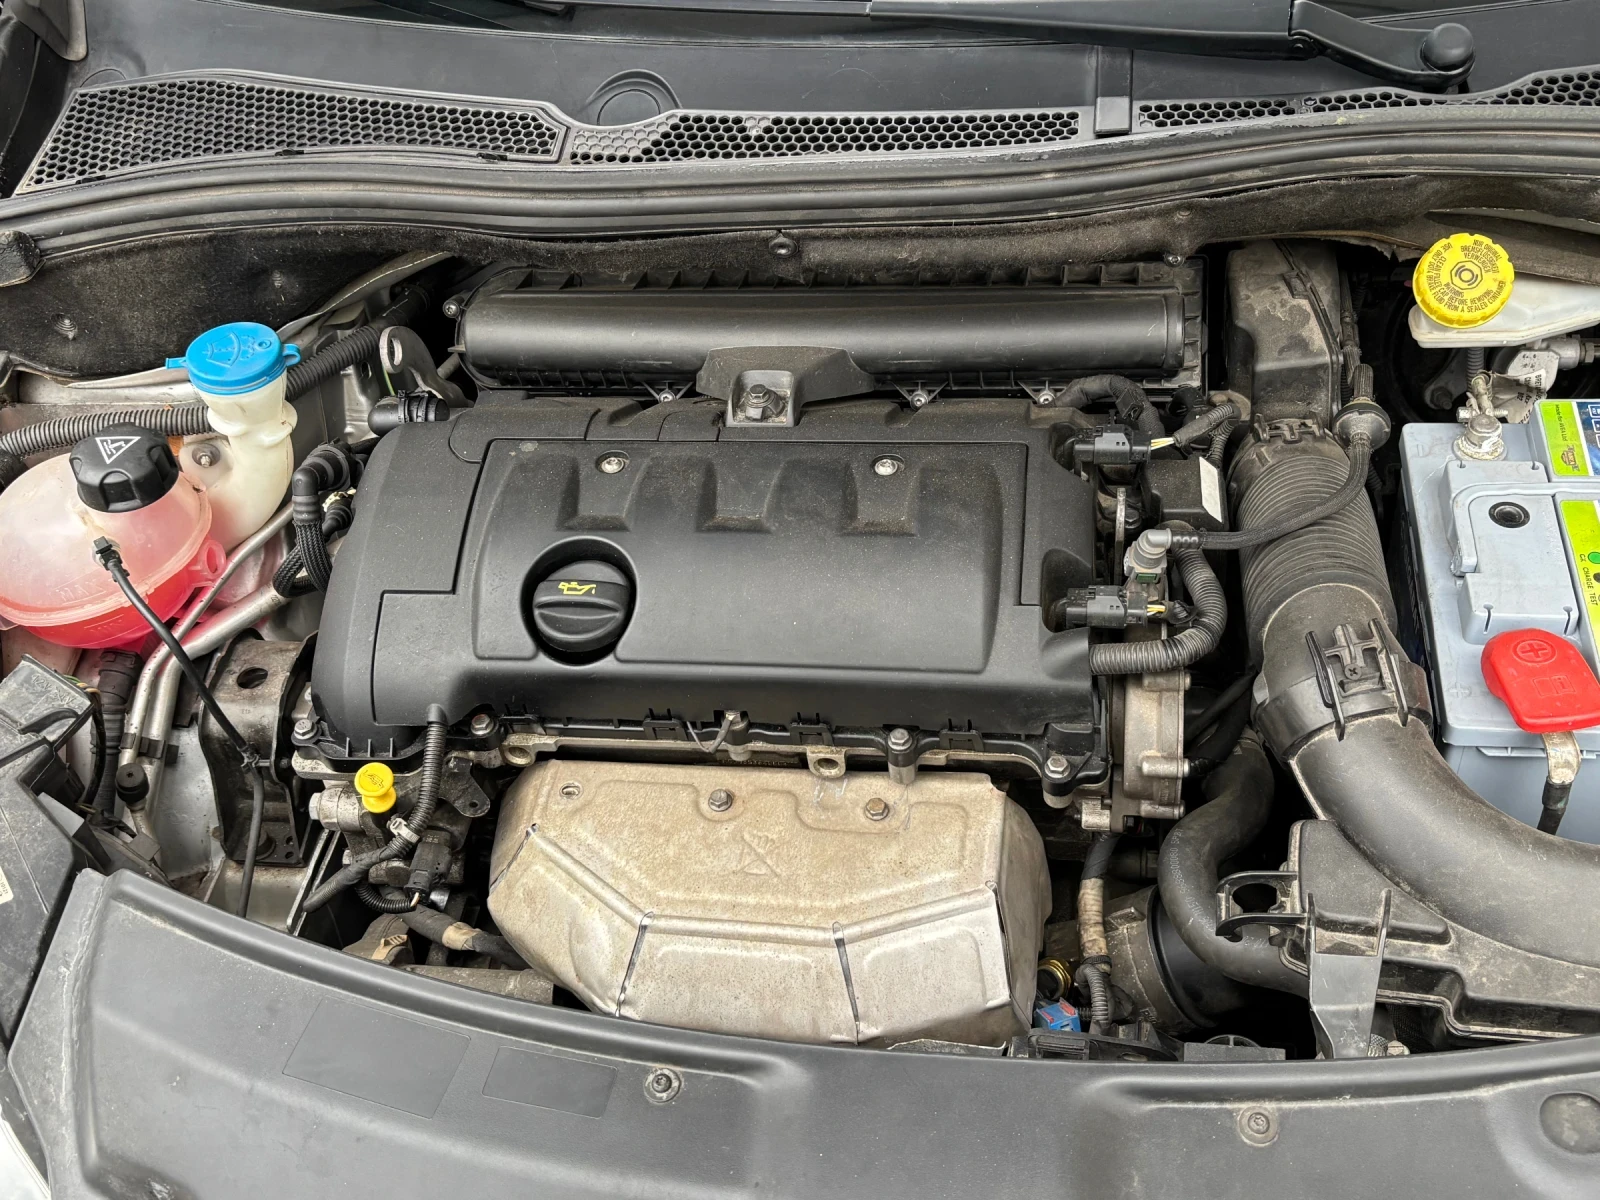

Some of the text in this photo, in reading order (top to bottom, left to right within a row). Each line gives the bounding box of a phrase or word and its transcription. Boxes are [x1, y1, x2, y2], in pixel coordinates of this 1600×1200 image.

[1441, 242, 1453, 252] USE
[1484, 244, 1502, 262] ORIGINAL
[1432, 249, 1442, 262] ONLY
[1426, 274, 1436, 292] BRAKE
[1433, 256, 1494, 306] CLEAN FILLER CAP BEFORE REMOVING
[1432, 290, 1445, 304] FLUID
[1443, 282, 1464, 298] WARNING
[1488, 280, 1506, 304] CONTAINER
[1444, 301, 1459, 312] FROM
[1466, 302, 1488, 313] SEALED
[1583, 567, 1594, 589] CHARGE
[1589, 592, 1598, 606] TEST
